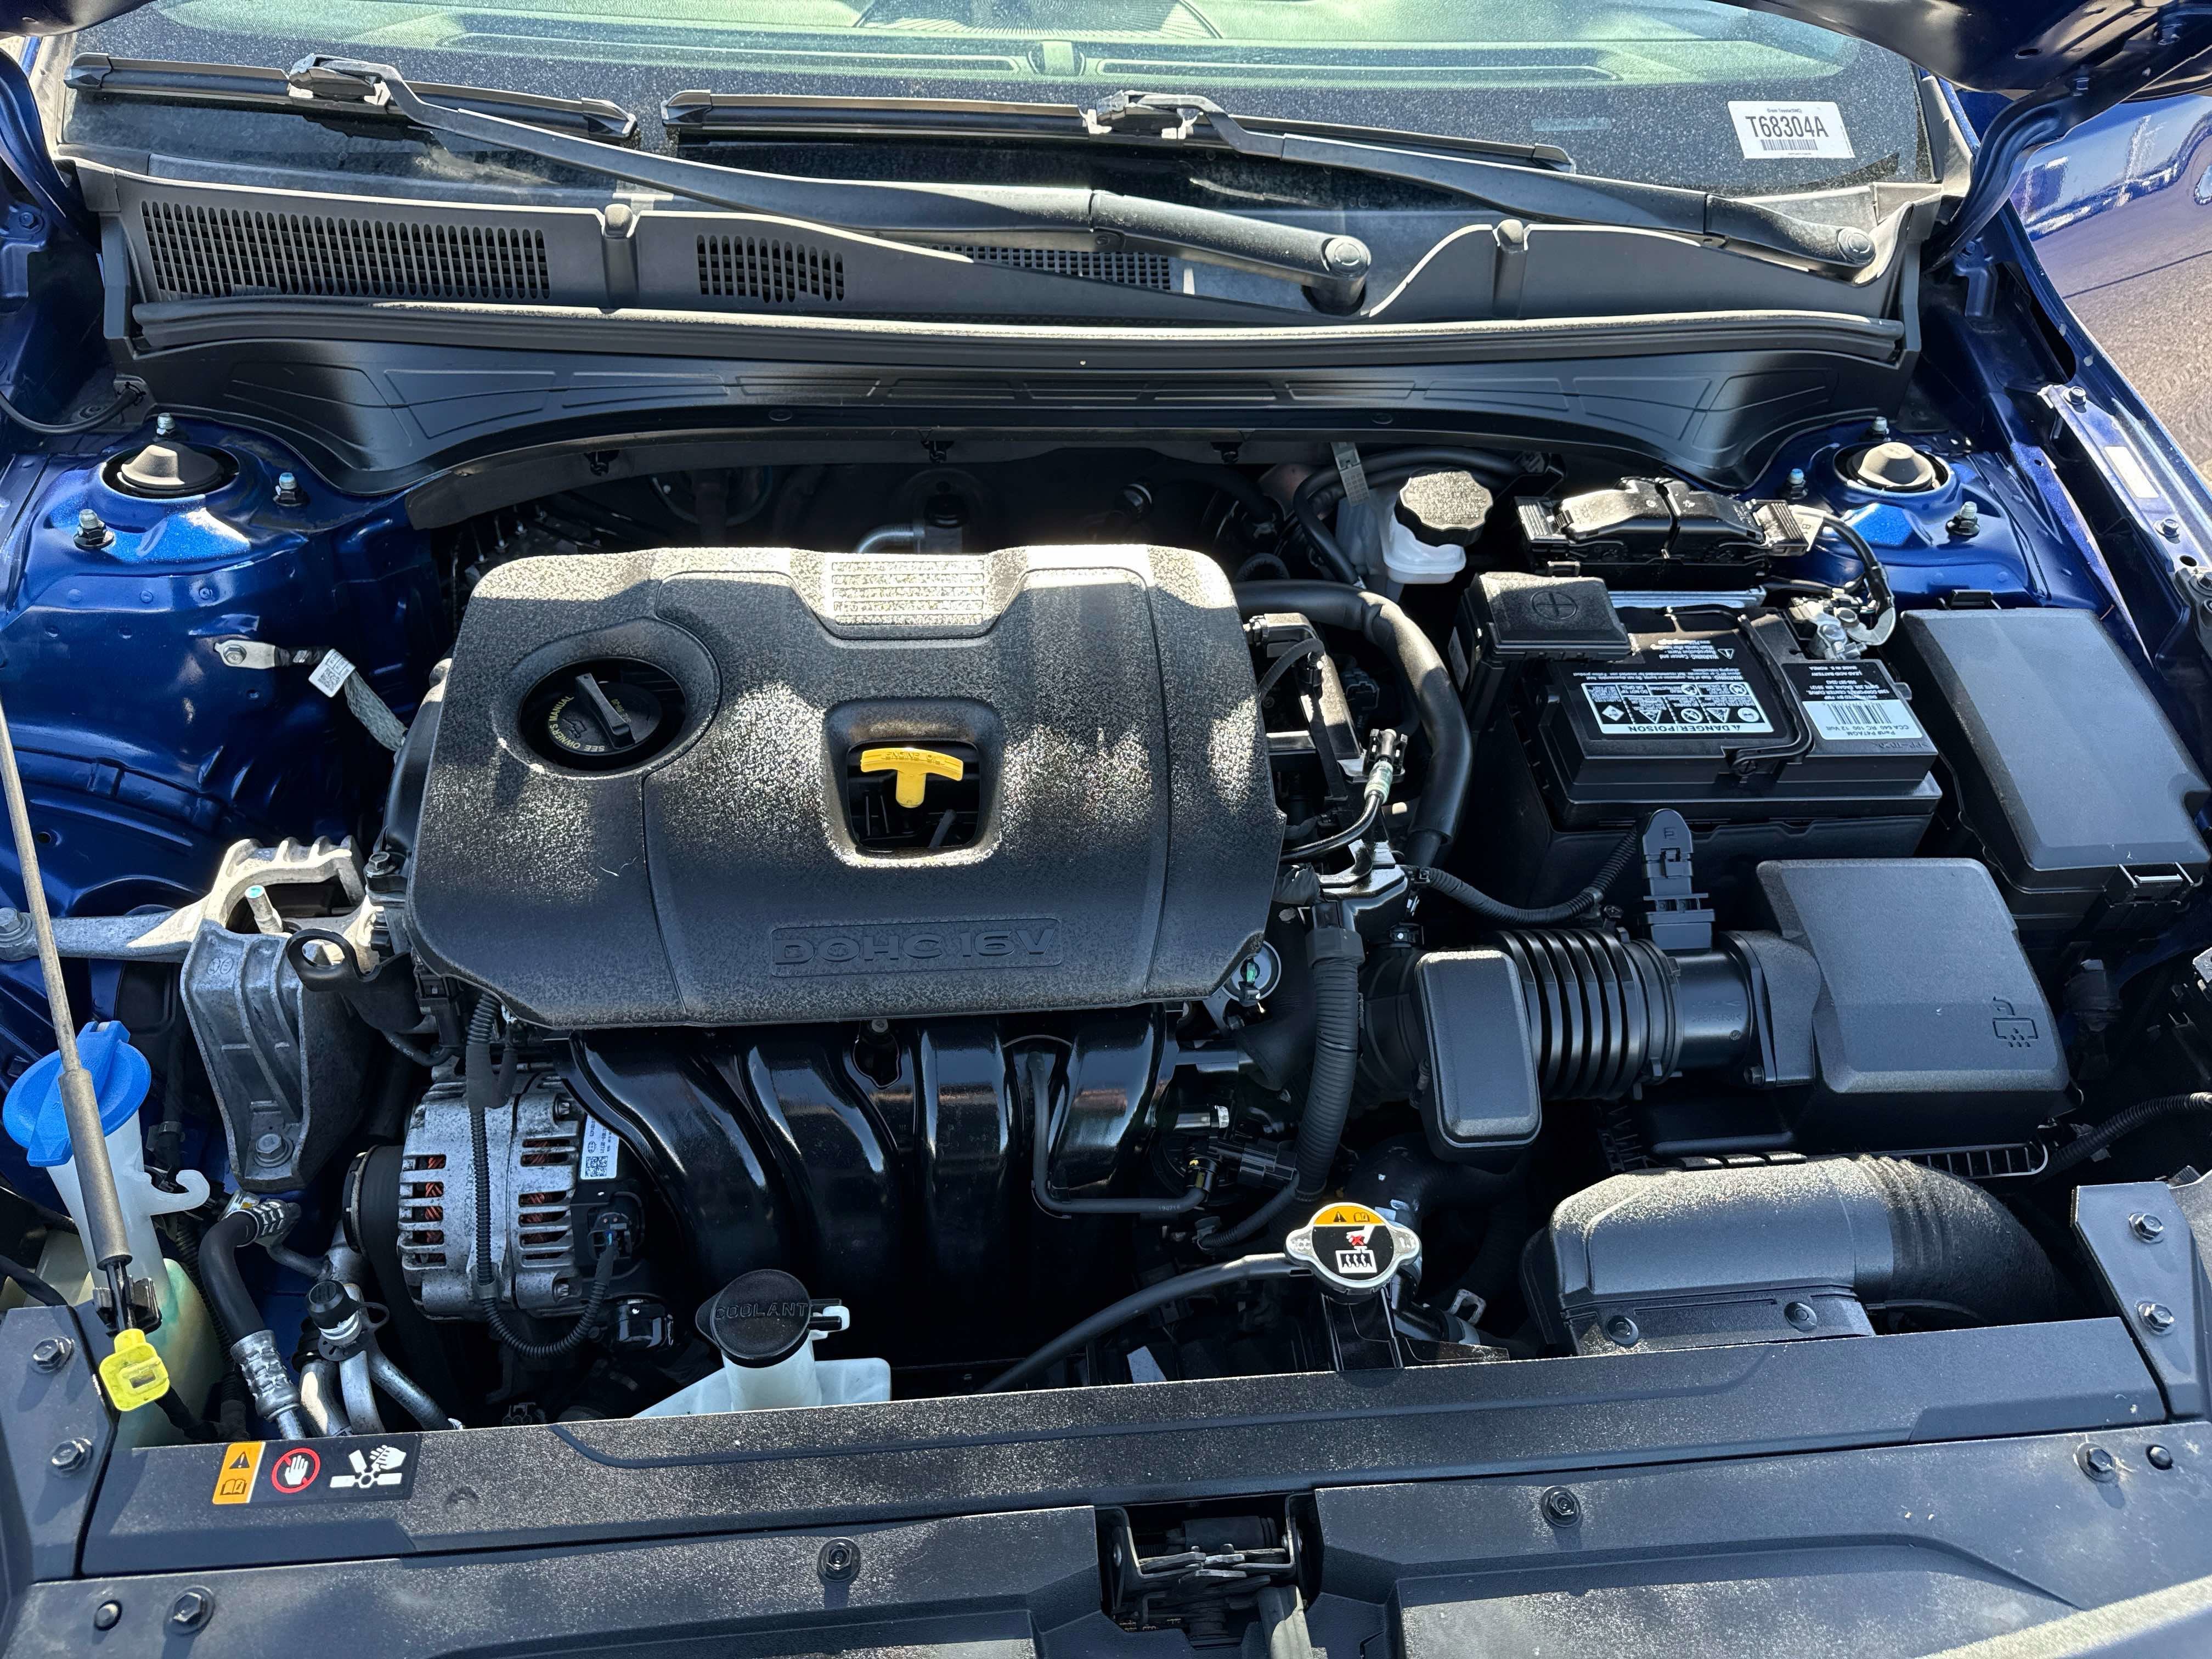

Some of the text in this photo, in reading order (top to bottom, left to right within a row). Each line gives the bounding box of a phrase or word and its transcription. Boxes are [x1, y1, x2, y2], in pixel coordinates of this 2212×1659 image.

[1745, 115, 1829, 138] T68304A
[549, 696, 574, 721] MANUAL
[549, 723, 581, 749] OWNER'S
[884, 751, 943, 765] ENGINE OIL
[774, 928, 1059, 966] DOHC 16V
[714, 1302, 809, 1321] COOLANT
